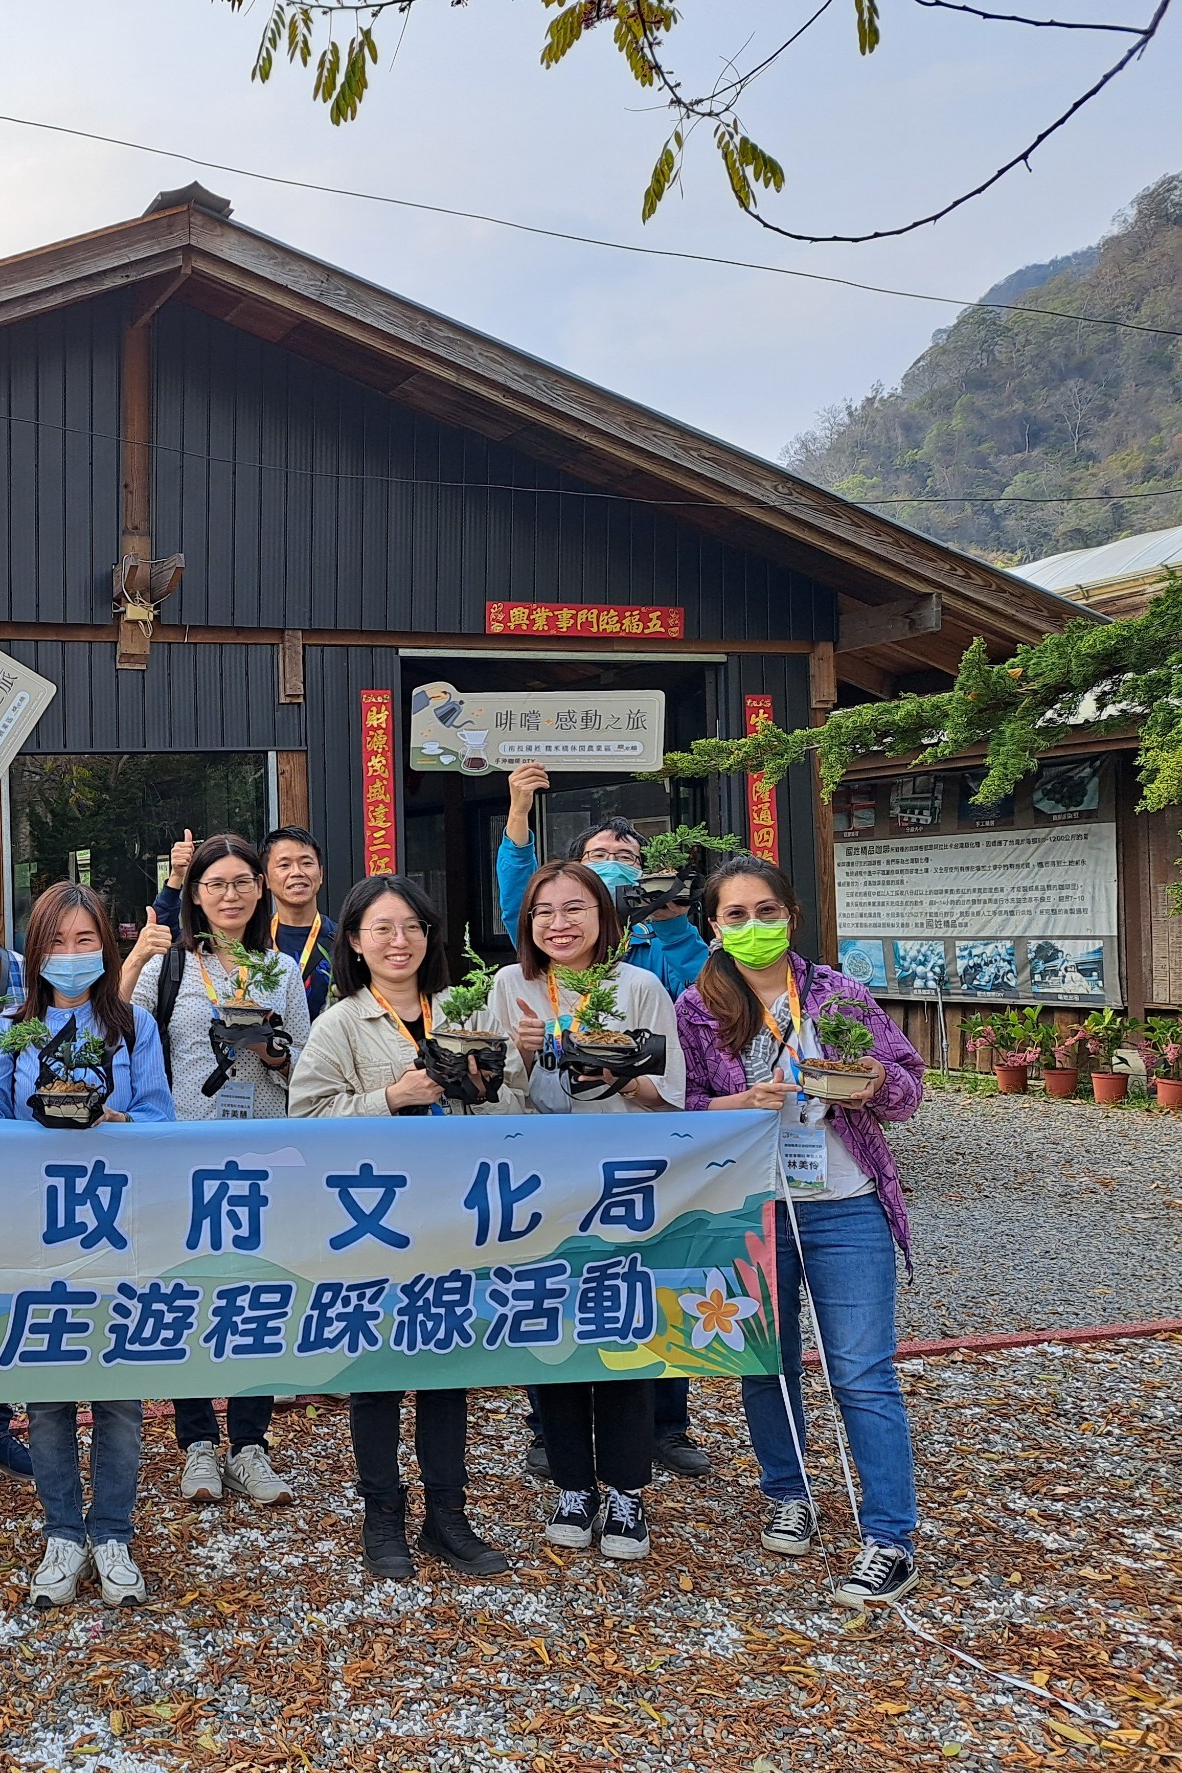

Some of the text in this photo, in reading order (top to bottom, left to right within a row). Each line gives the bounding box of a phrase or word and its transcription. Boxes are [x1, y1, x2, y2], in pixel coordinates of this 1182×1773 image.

[495, 708, 648, 733] 啡嚐 感動之旅
